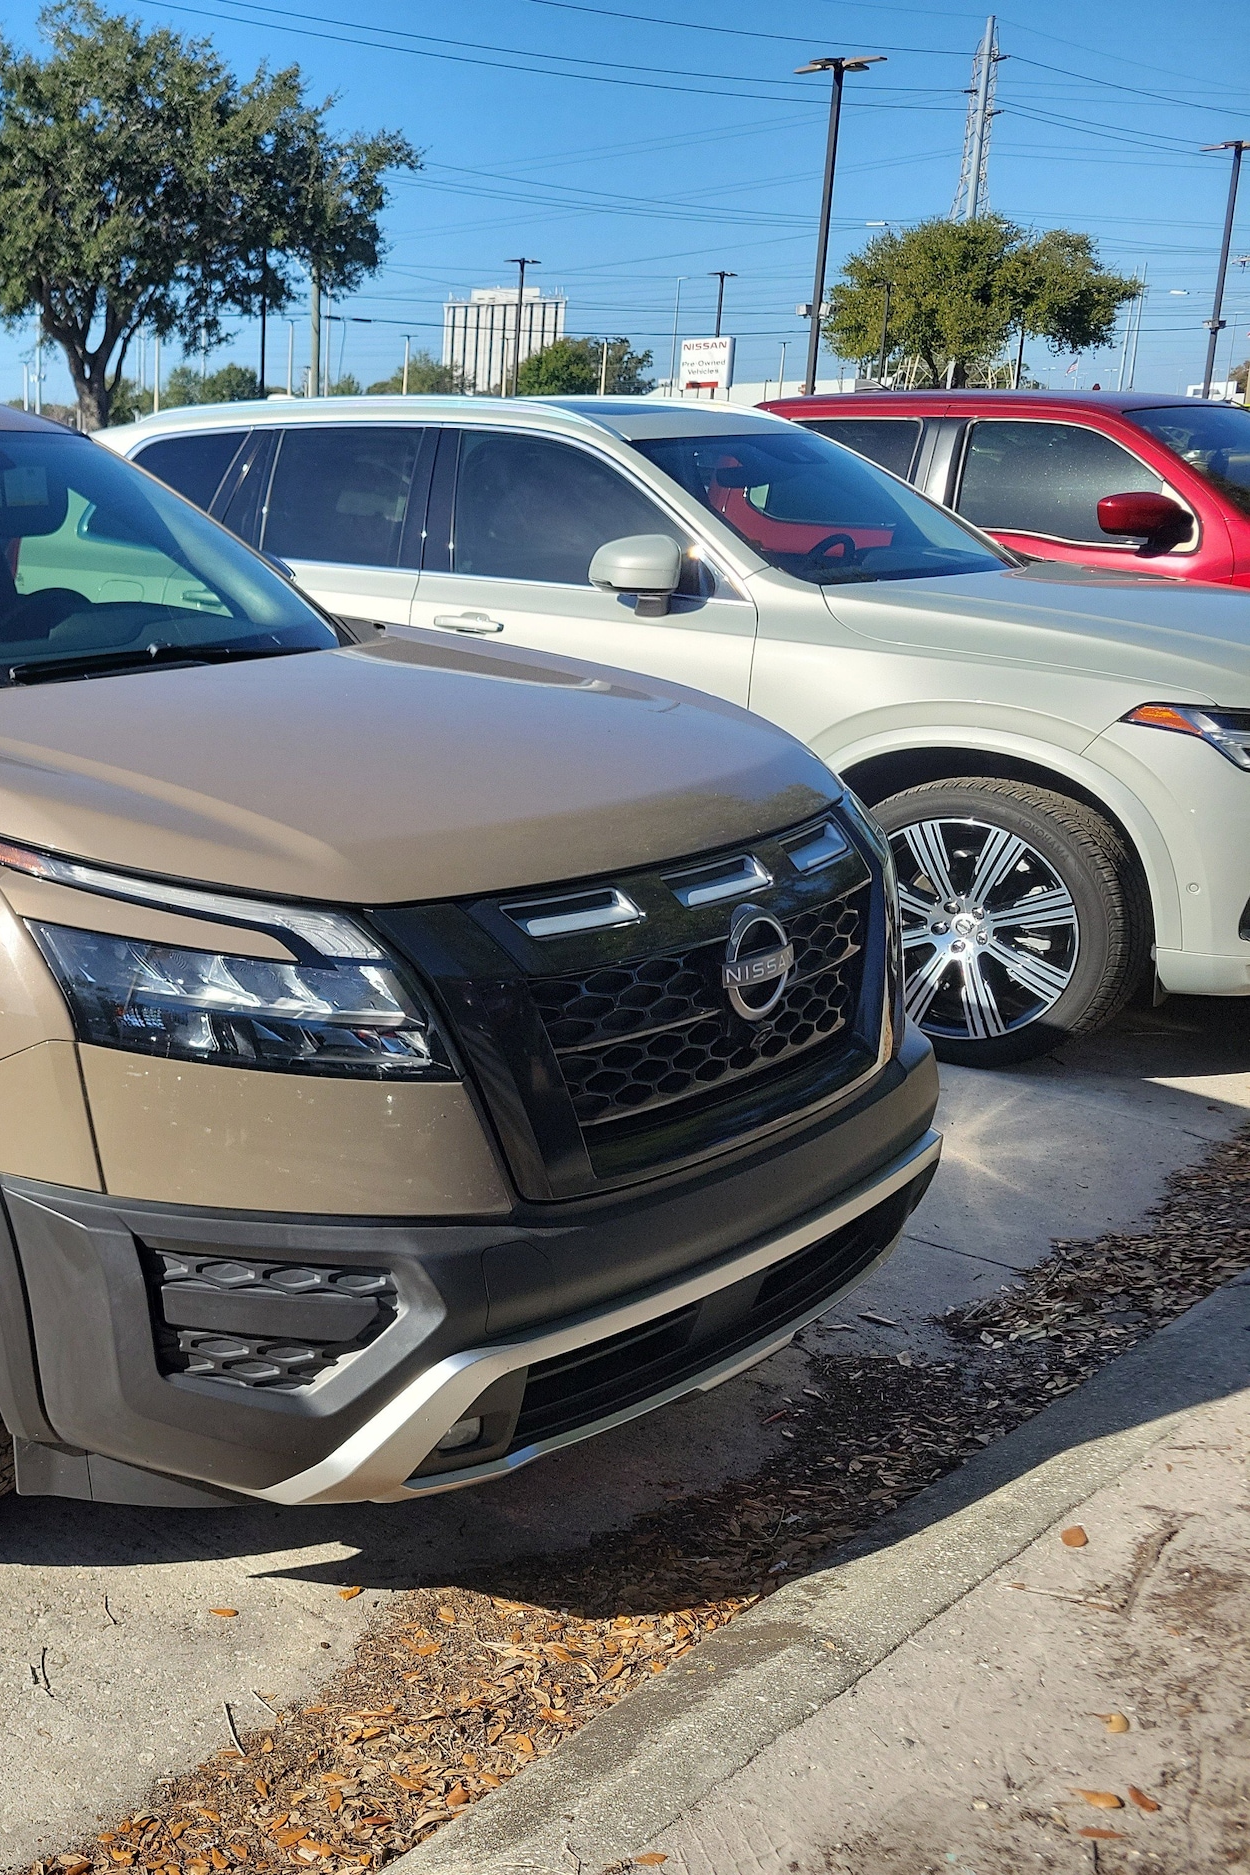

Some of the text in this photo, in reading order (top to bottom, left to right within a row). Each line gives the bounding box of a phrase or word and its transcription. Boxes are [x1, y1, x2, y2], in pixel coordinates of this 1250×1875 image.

[683, 341, 727, 351] NISSAN
[1018, 816, 1070, 862] YOKOHAMA
[725, 950, 793, 984] NISSAN
